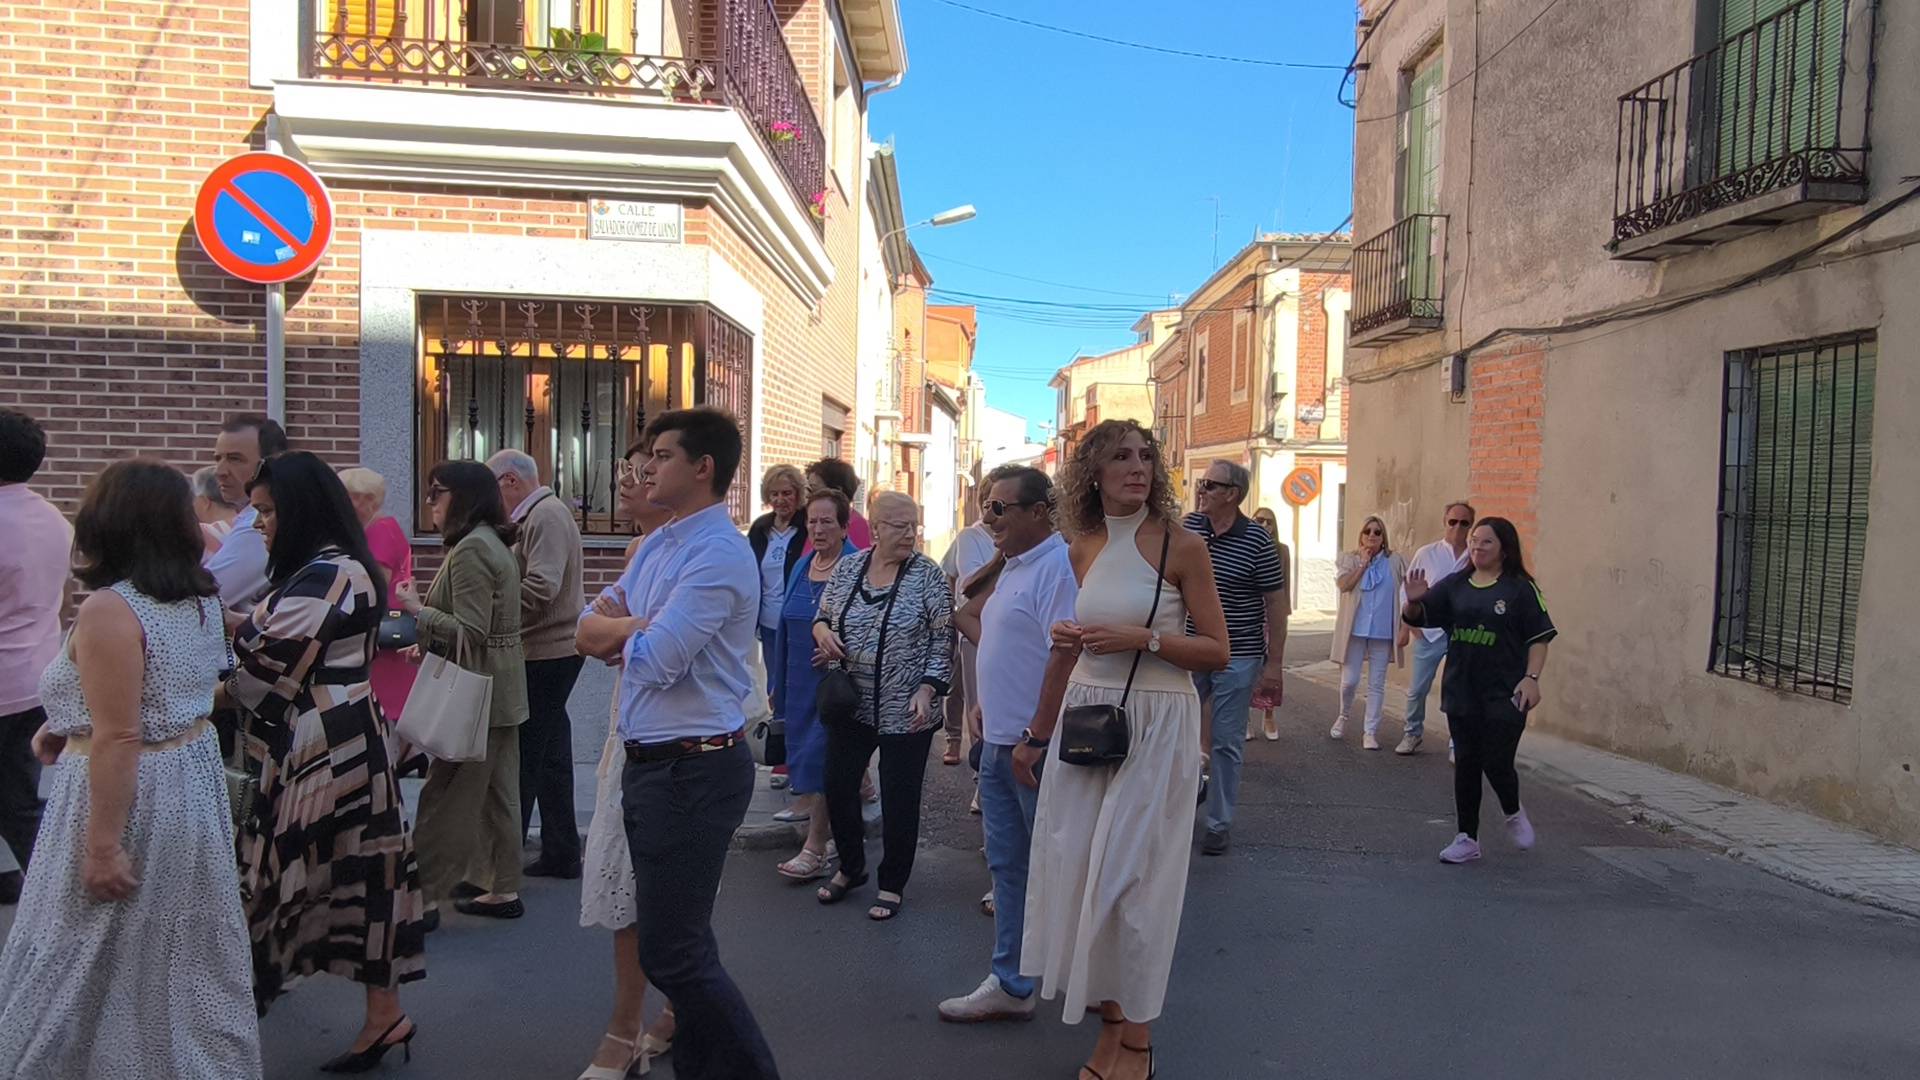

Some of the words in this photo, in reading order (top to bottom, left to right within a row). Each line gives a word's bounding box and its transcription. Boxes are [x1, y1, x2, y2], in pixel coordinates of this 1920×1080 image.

[618, 203, 656, 217] CALLE
[594, 219, 626, 236] SALVADOR
[648, 222, 657, 237] DE
